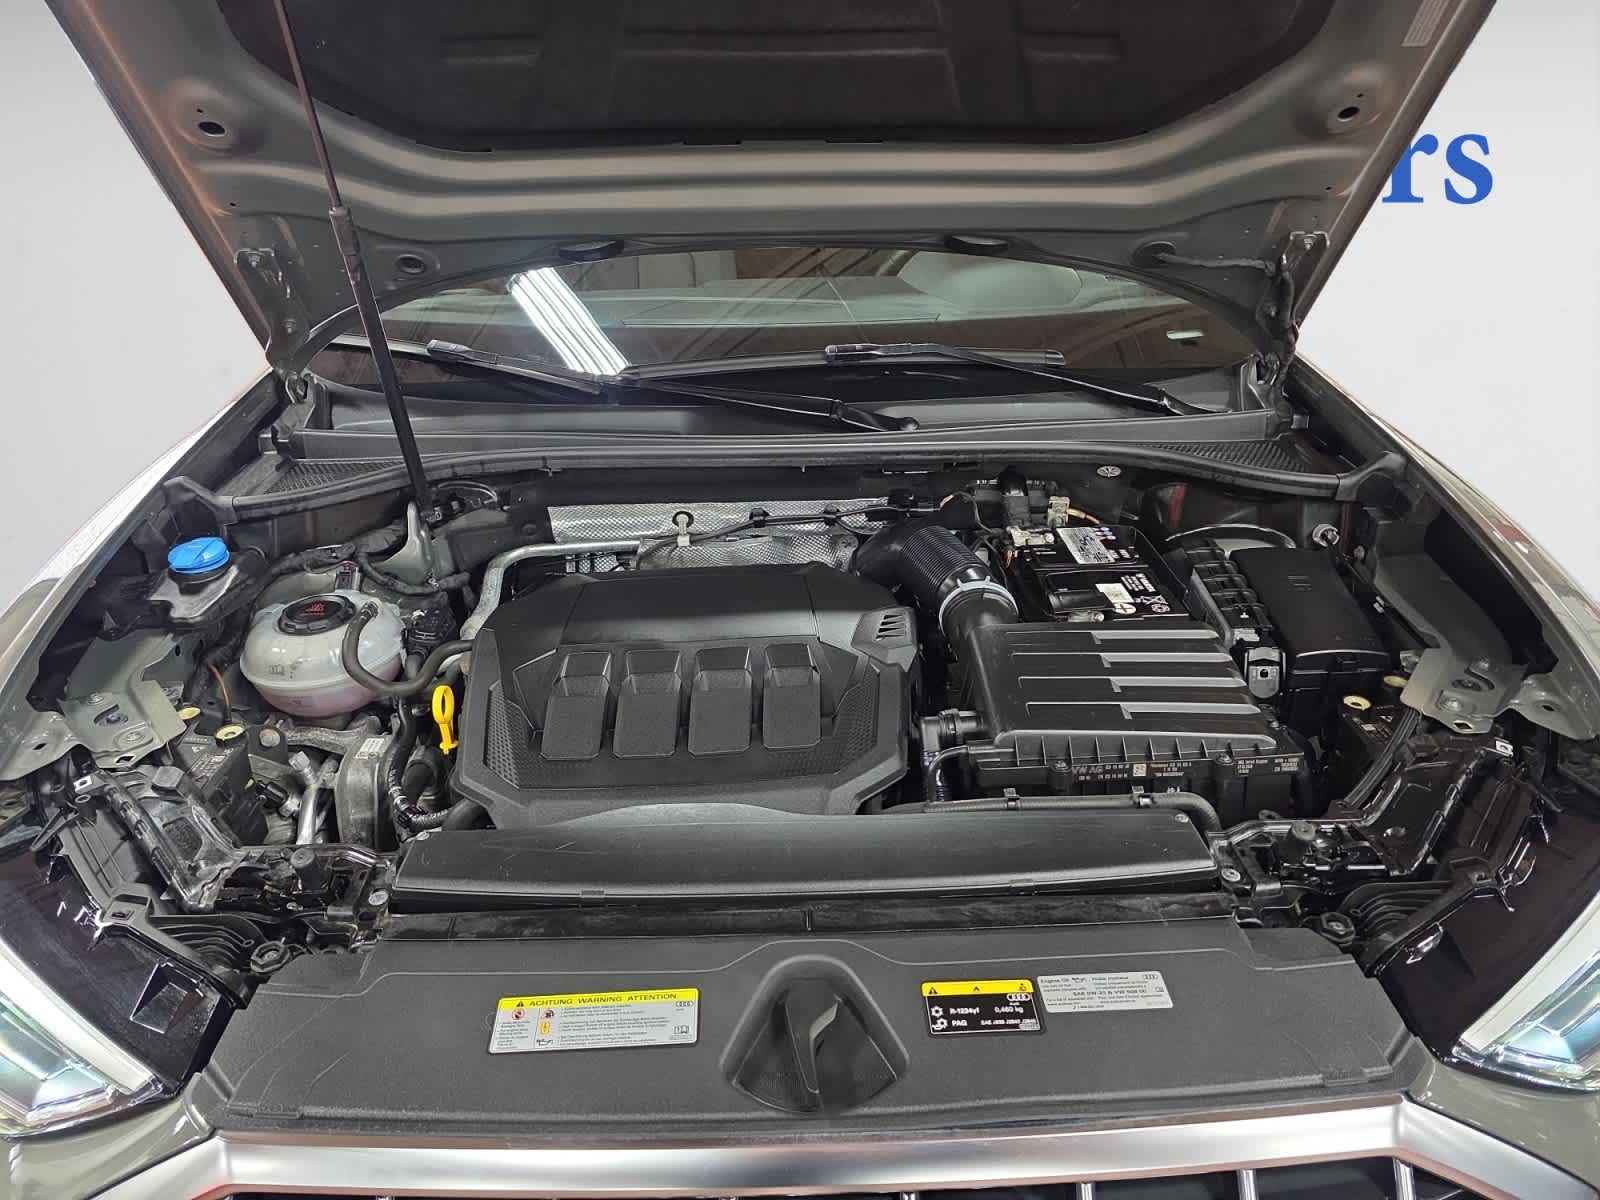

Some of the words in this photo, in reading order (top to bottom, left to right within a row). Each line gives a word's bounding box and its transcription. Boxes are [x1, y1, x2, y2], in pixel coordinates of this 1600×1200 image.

[528, 998, 574, 1007] ACHTUNG
[577, 995, 623, 1005] WARNING
[626, 992, 678, 1002] ATTENTION
